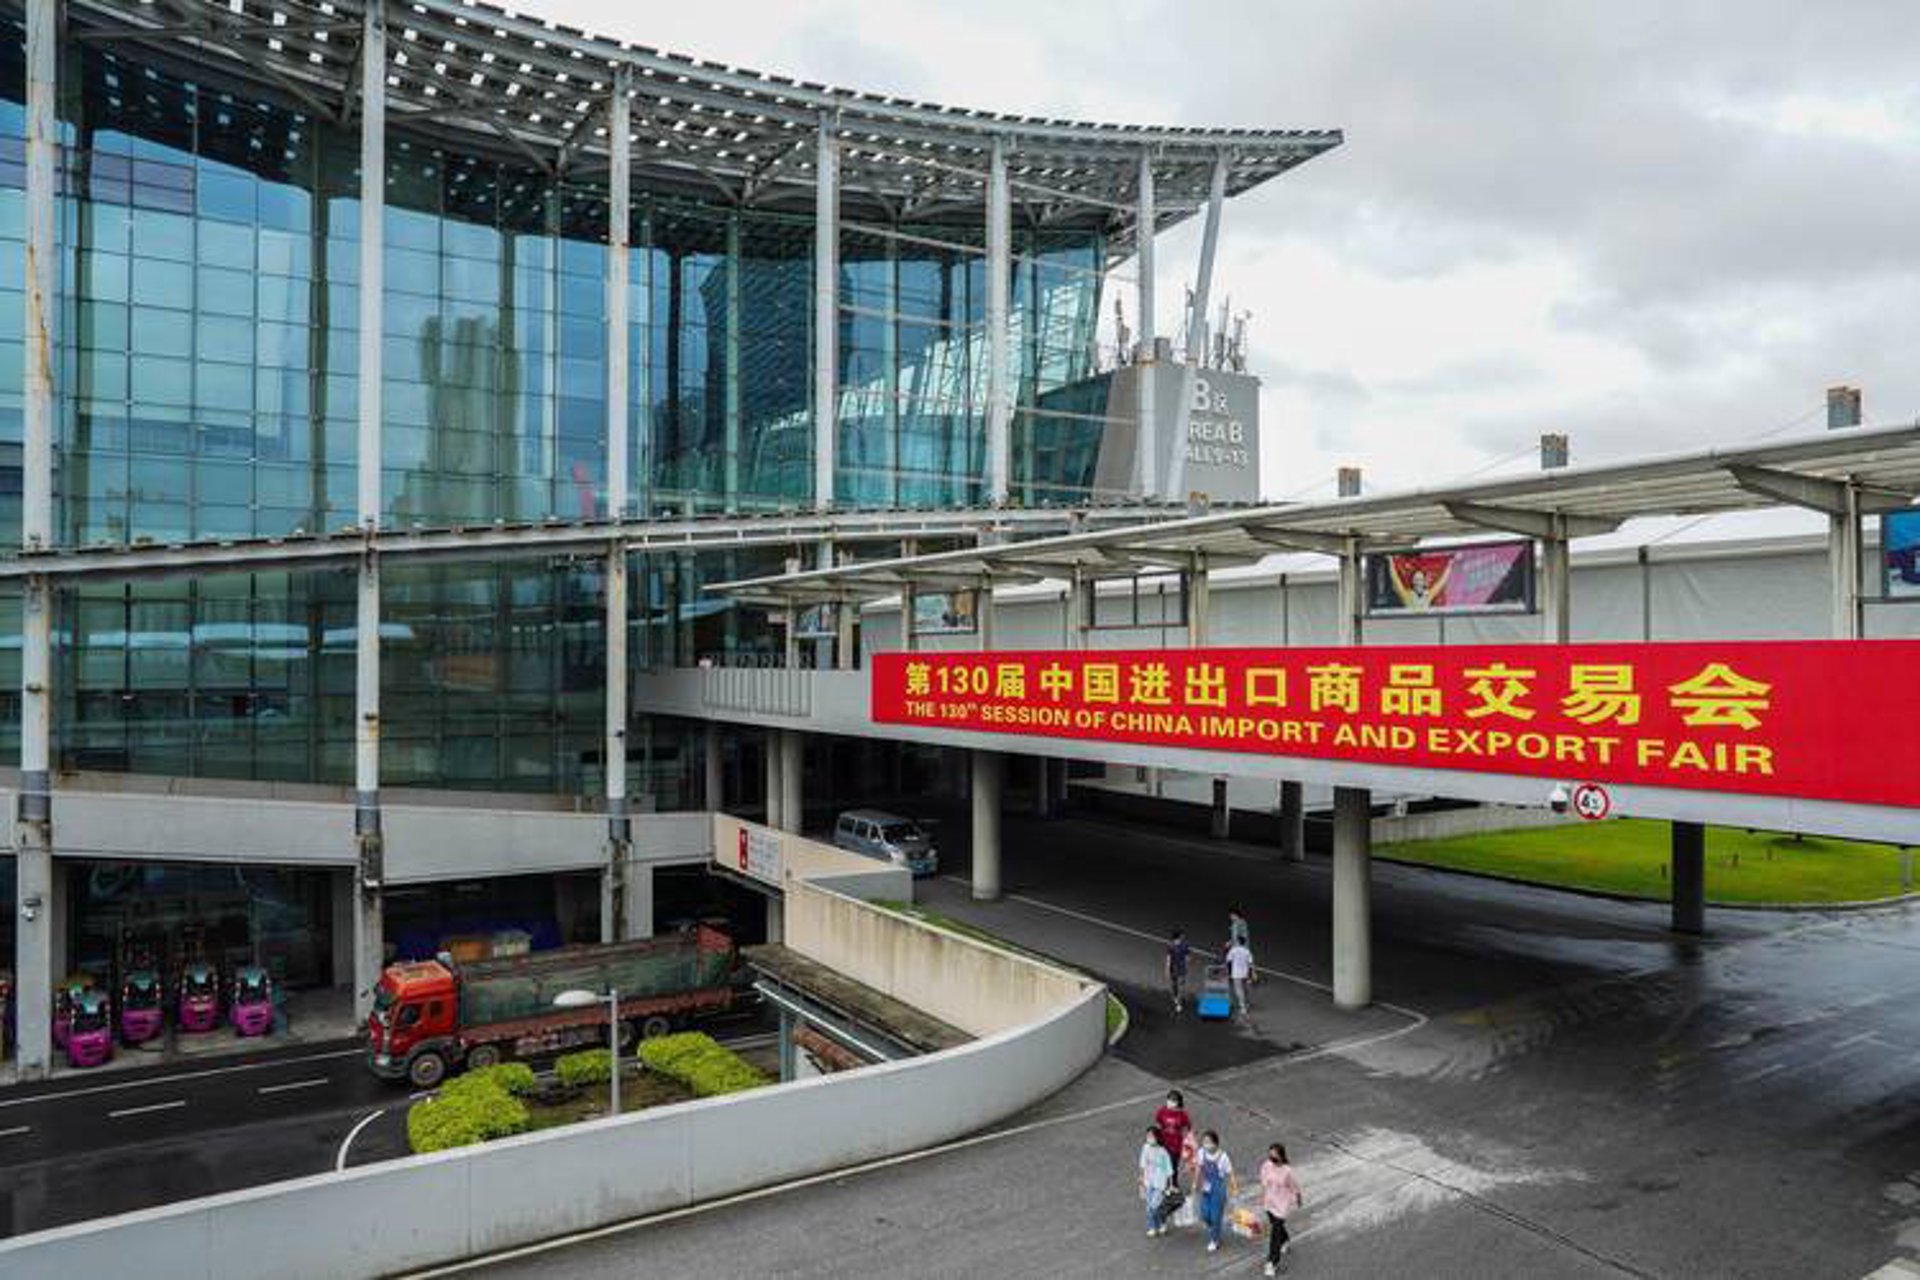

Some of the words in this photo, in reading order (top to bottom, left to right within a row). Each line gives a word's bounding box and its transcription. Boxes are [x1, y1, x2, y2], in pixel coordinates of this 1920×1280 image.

[1190, 421, 1226, 441] REA
[1229, 421, 1243, 443] B
[906, 701, 935, 717] THE
[981, 705, 1070, 727] SESSION
[1075, 710, 1105, 728] OF
[1111, 712, 1191, 736] CHINA
[1200, 716, 1324, 744] IMPORT
[1333, 723, 1416, 750] AND
[1428, 727, 1620, 765] EXPORT
[1637, 739, 1774, 775] FAIR
